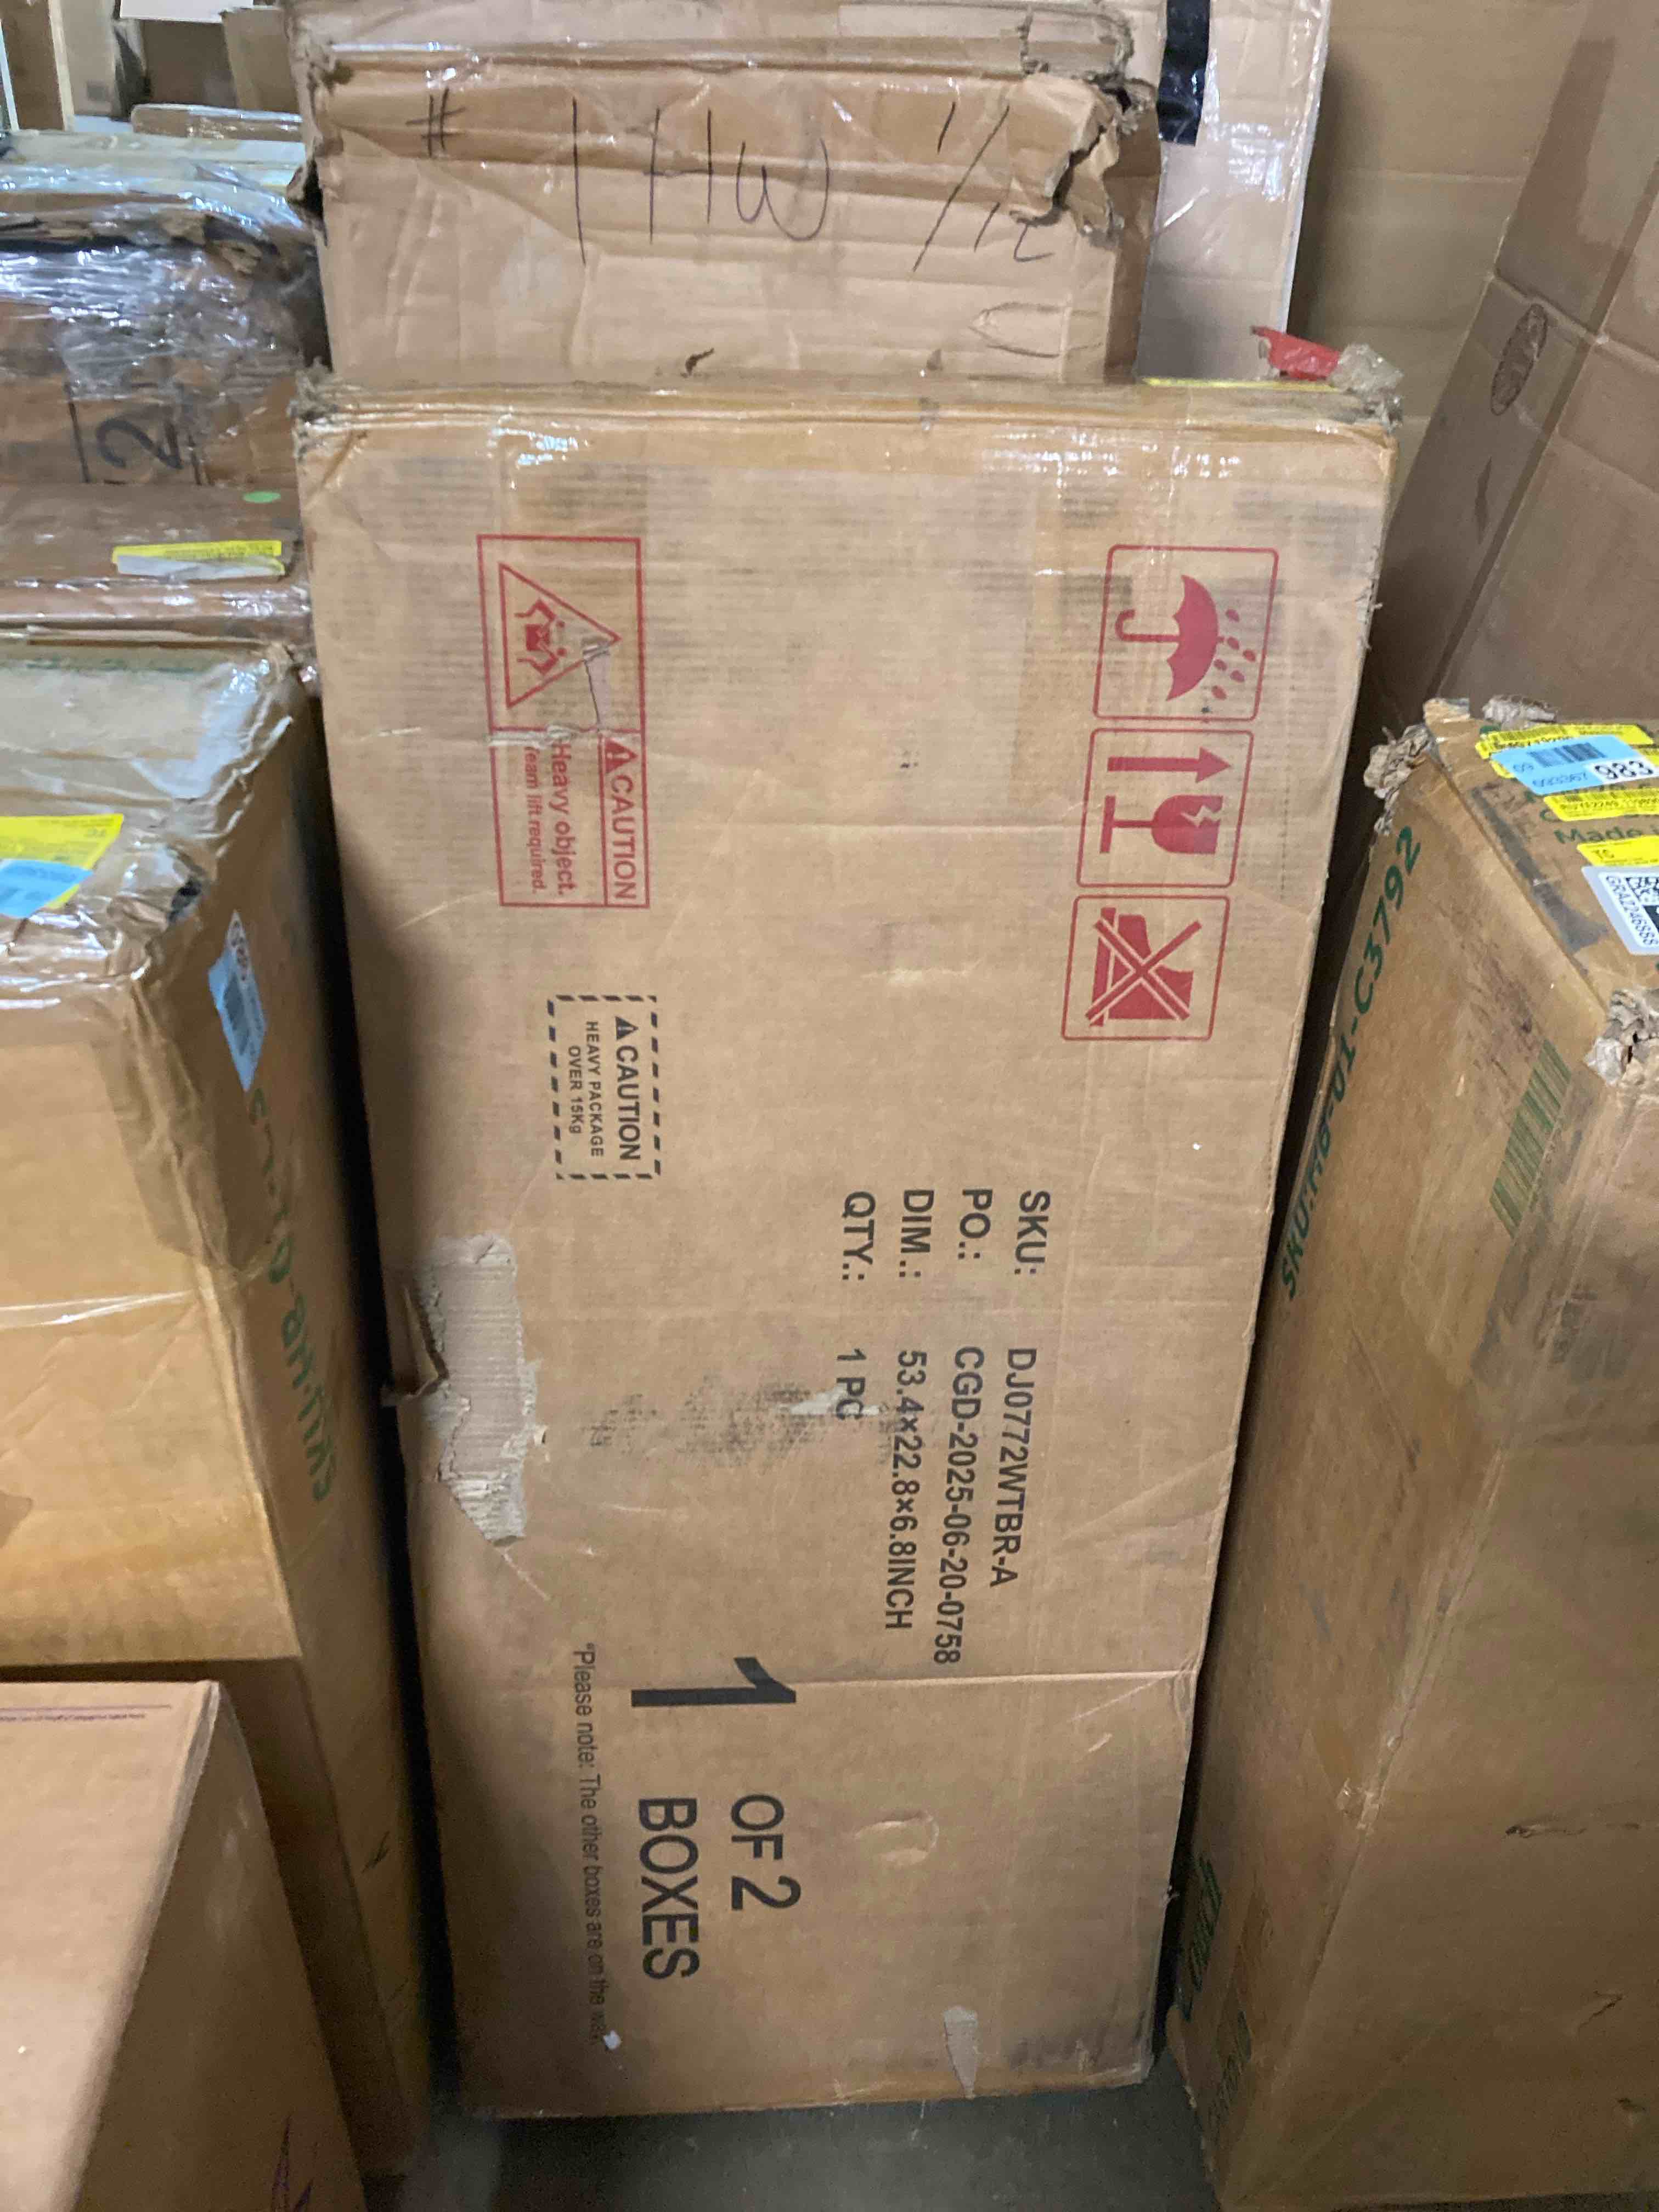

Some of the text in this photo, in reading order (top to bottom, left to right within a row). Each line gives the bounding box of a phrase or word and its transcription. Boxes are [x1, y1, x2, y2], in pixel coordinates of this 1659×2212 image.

[527, 794, 543, 816] lift
[549, 743, 577, 895] Heavy object.
[611, 774, 637, 899] CAUTION
[526, 820, 547, 894] required.
[568, 1046, 584, 1134] OVER 15Kg
[586, 1021, 604, 1156] HEAVY PACKAGE
[616, 1046, 641, 1160] CAUTION
[835, 1191, 876, 1420] QTY.: 1 PC
[933, 1189, 993, 1664] PO.: CGD-2025-06-20-0758
[990, 1190, 1051, 1587] SKU: DJ0772WTBR-A
[631, 1657, 797, 1708] 1
[577, 1723, 597, 1769] note:
[579, 1774, 601, 1809] The
[581, 1814, 602, 1861] other
[730, 1794, 801, 1911] OF 2
[583, 1865, 602, 1917] boxes
[639, 1798, 700, 1980] BOXES
[586, 1922, 603, 1949] are
[588, 1953, 605, 1974] on
[589, 1979, 609, 2005] the
